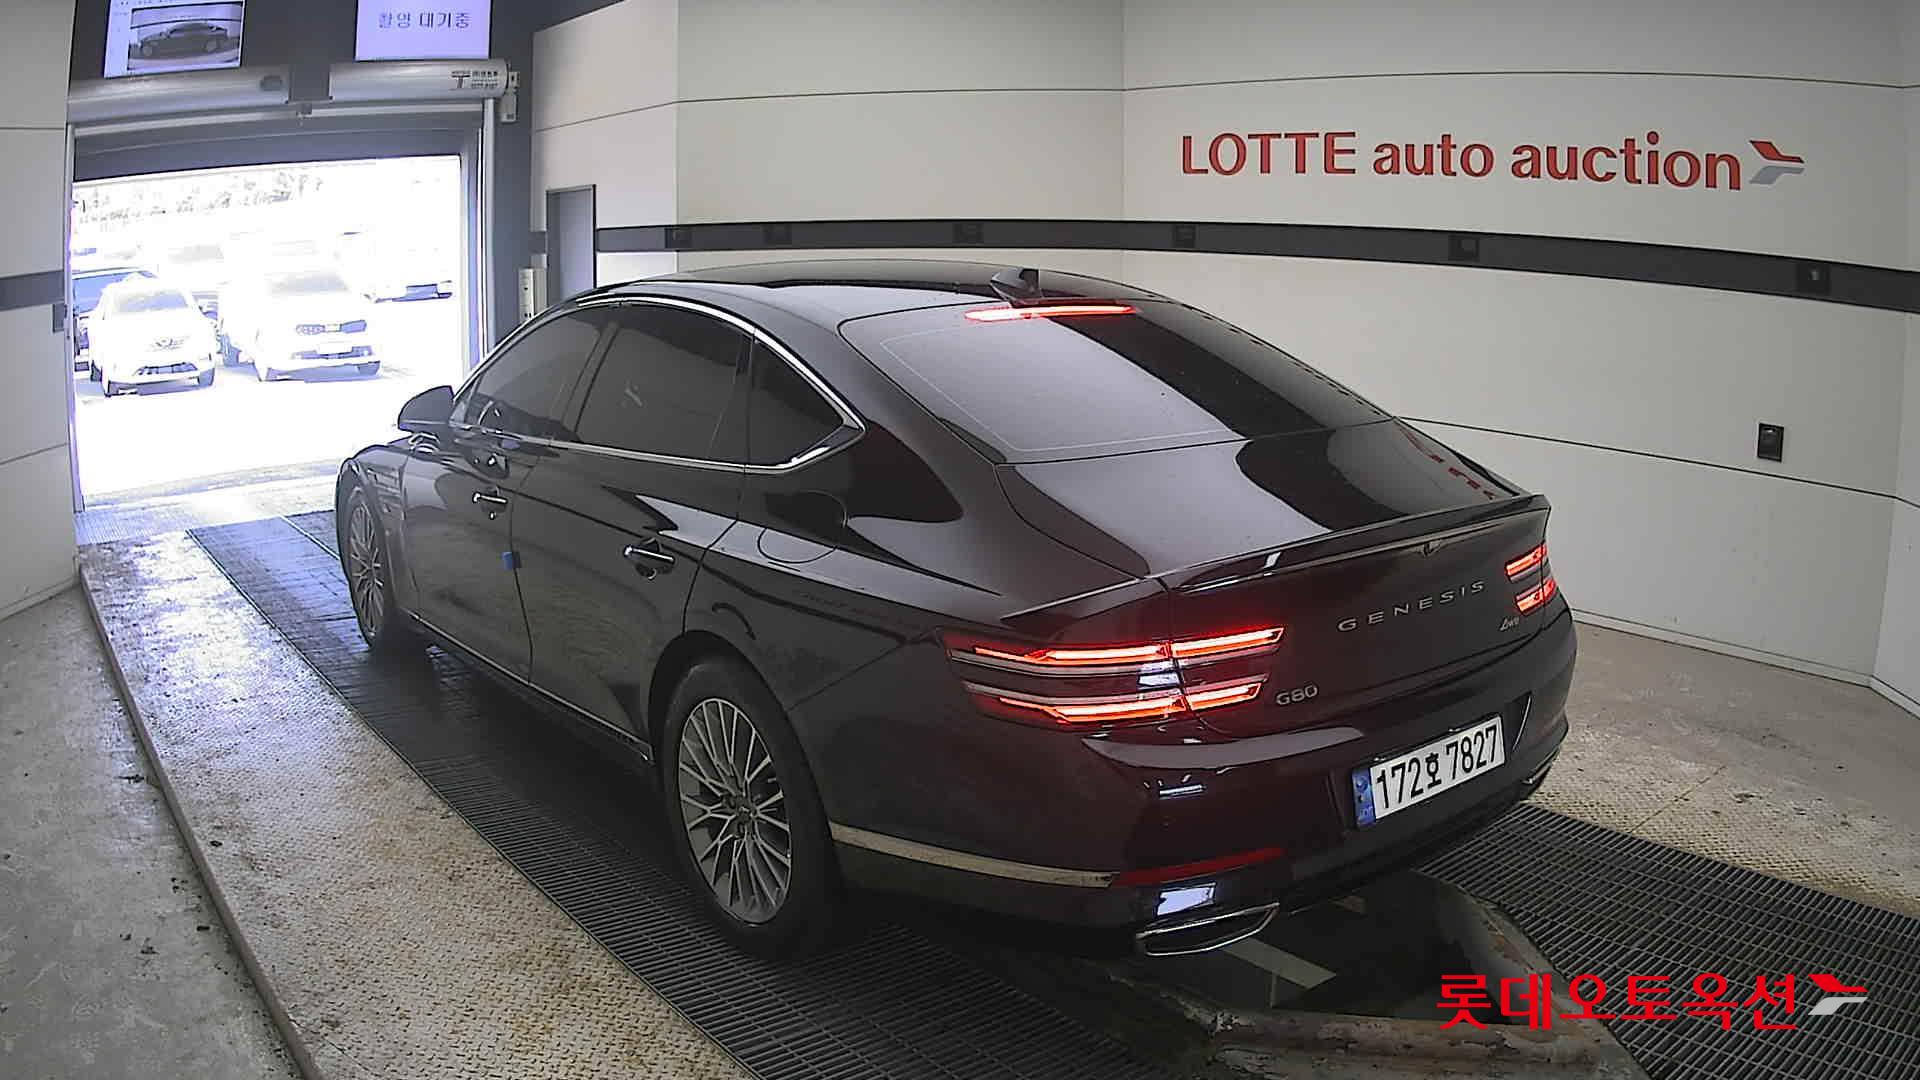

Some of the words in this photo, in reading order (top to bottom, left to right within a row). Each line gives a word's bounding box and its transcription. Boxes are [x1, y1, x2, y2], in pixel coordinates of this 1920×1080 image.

[420, 11, 472, 28] 대기중
[1181, 132, 1357, 175] LOTTE
[1372, 134, 1496, 178] auto
[1510, 131, 1742, 191] auction
[1337, 581, 1485, 632] GENESIS
[1275, 686, 1319, 705] G80
[1376, 752, 1442, 809] 172호
[1446, 725, 1497, 779] 7827
